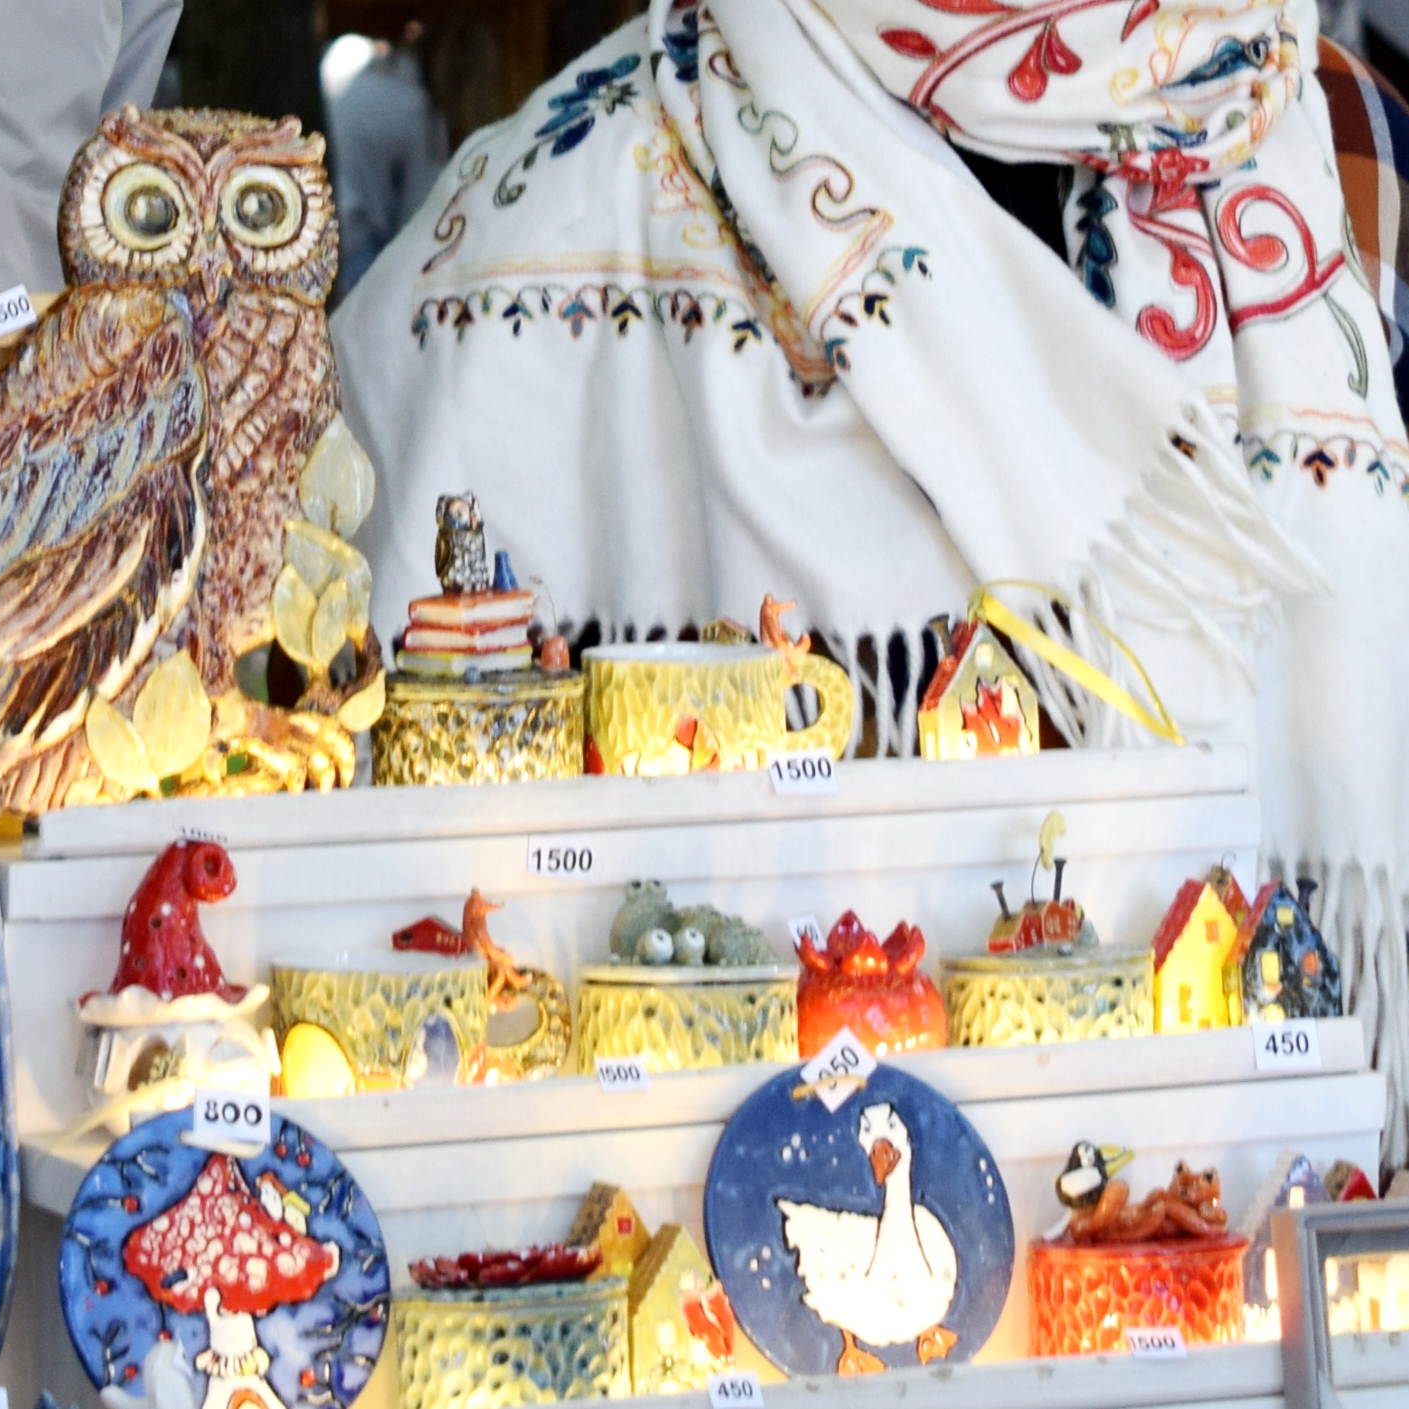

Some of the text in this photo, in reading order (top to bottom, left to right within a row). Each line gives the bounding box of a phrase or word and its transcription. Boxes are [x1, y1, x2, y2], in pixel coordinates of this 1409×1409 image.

[772, 756, 832, 781] 1500
[532, 847, 591, 872] 1500
[1265, 1030, 1309, 1056] 450
[599, 1063, 640, 1082] 1500
[204, 1099, 262, 1126] 800
[1130, 1335, 1176, 1350] 1500
[717, 1380, 753, 1399] 450
